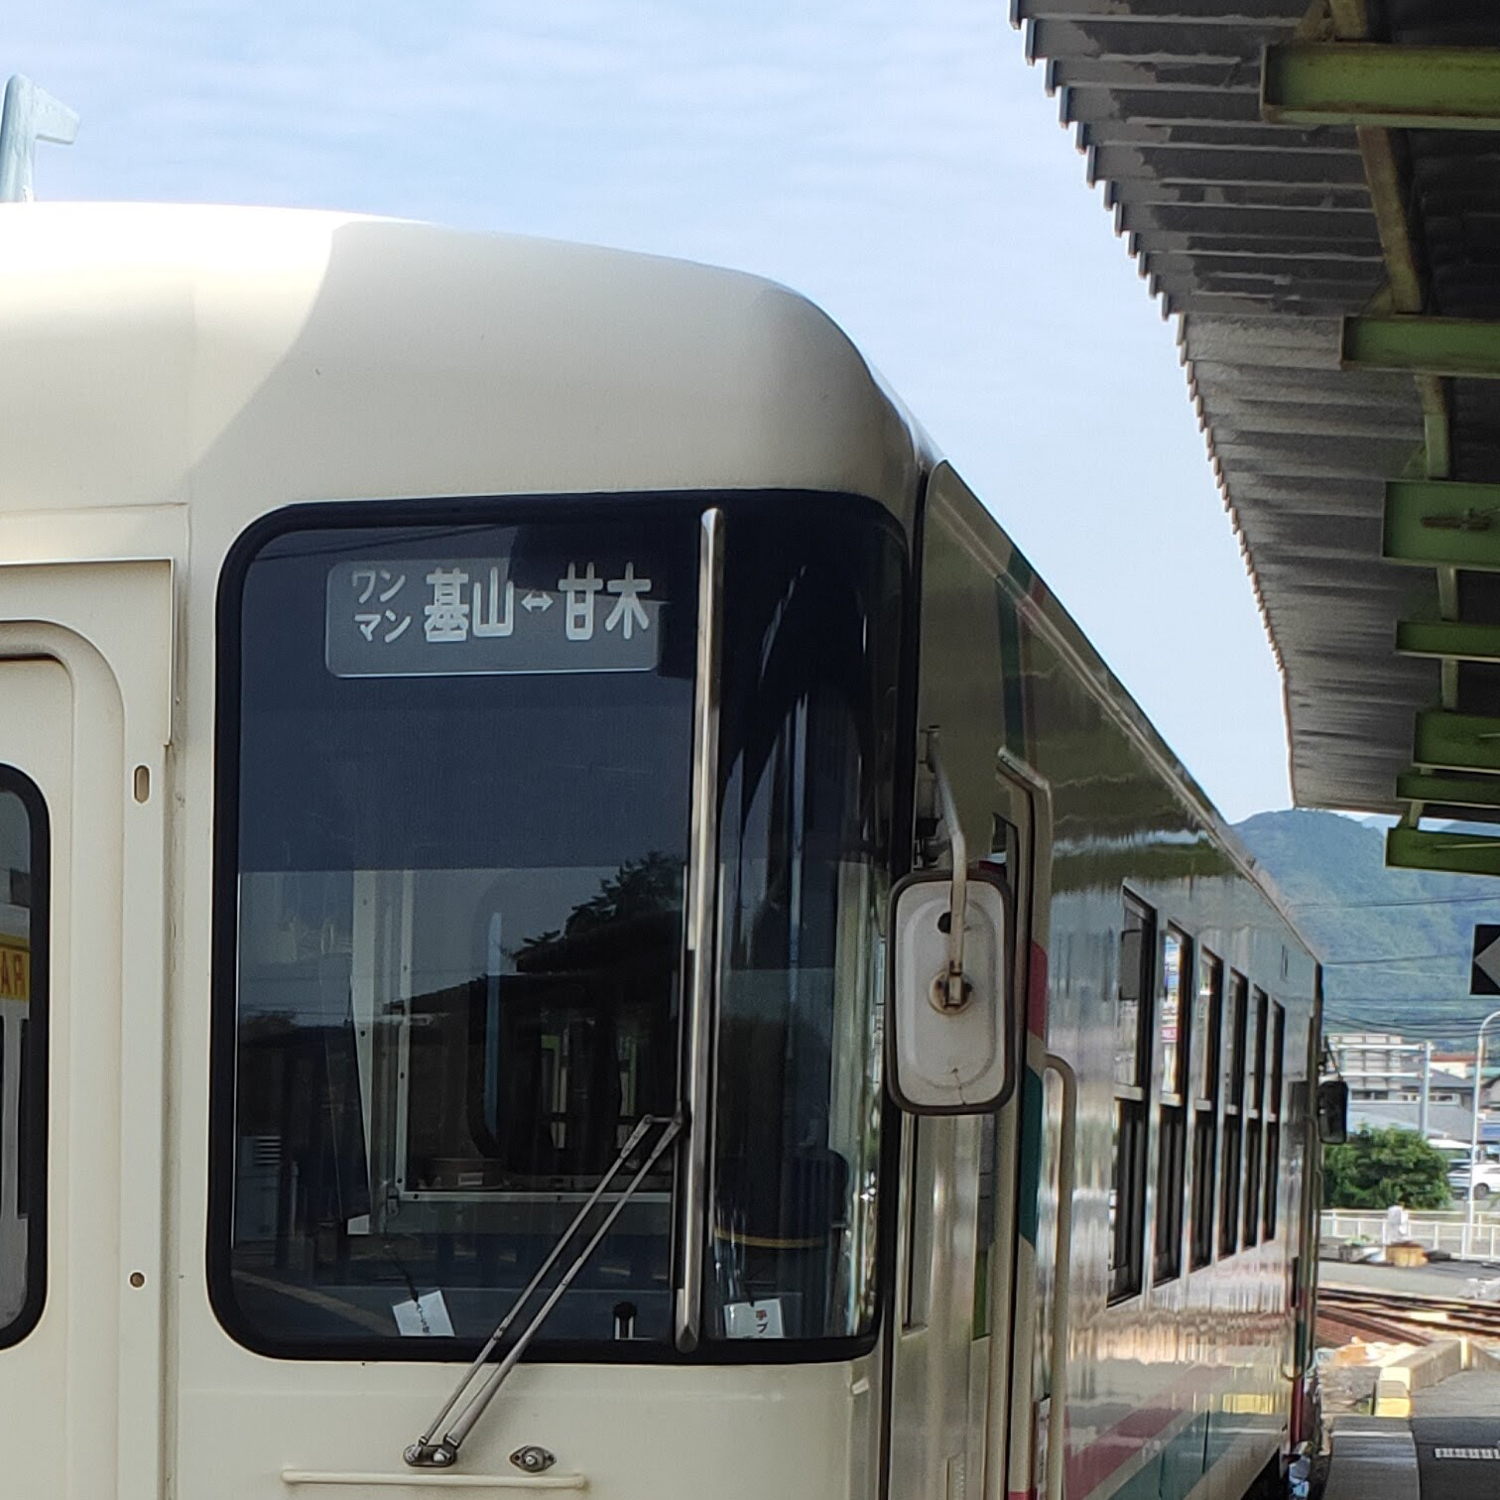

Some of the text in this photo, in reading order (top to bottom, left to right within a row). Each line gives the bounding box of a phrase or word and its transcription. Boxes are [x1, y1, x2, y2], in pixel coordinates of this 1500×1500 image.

[352, 567, 406, 604] ワン
[423, 560, 652, 642] 基山 甘木
[354, 609, 412, 643] マン
